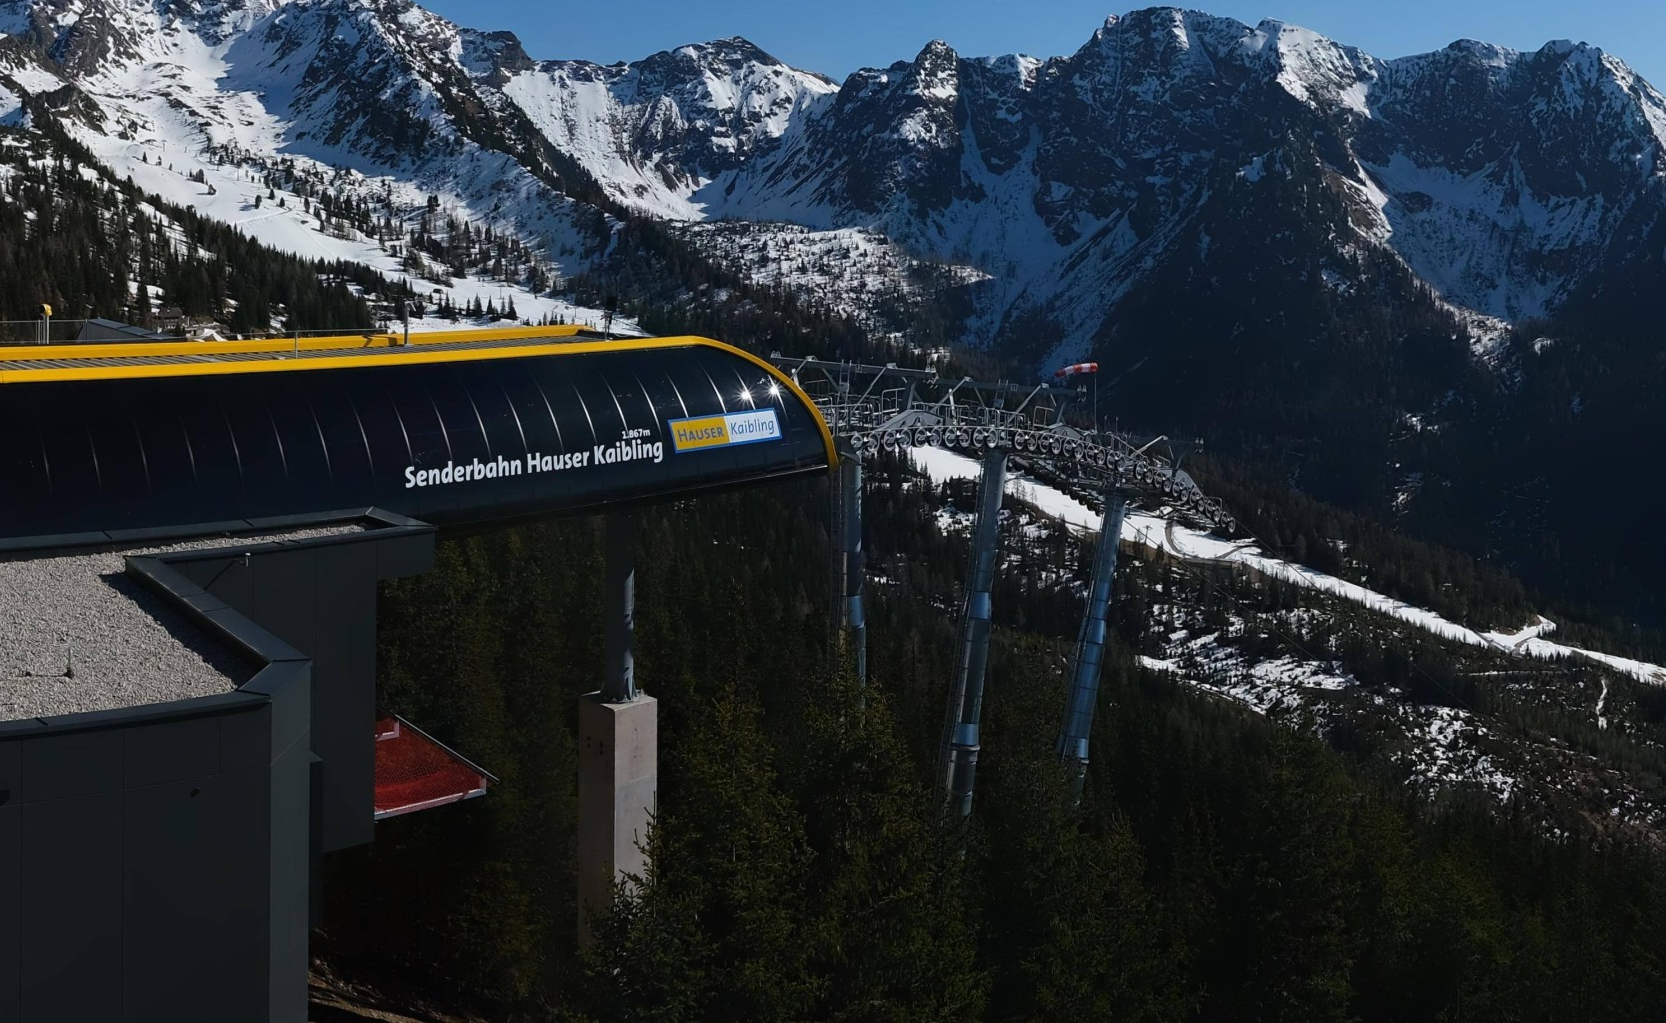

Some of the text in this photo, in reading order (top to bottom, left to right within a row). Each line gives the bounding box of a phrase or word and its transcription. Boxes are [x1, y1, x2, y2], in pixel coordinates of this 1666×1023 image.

[621, 429, 651, 439] 1.867m
[677, 419, 774, 442] HAUSER Kaibling
[405, 438, 663, 488] Senderbahn Hauser Kaibling
